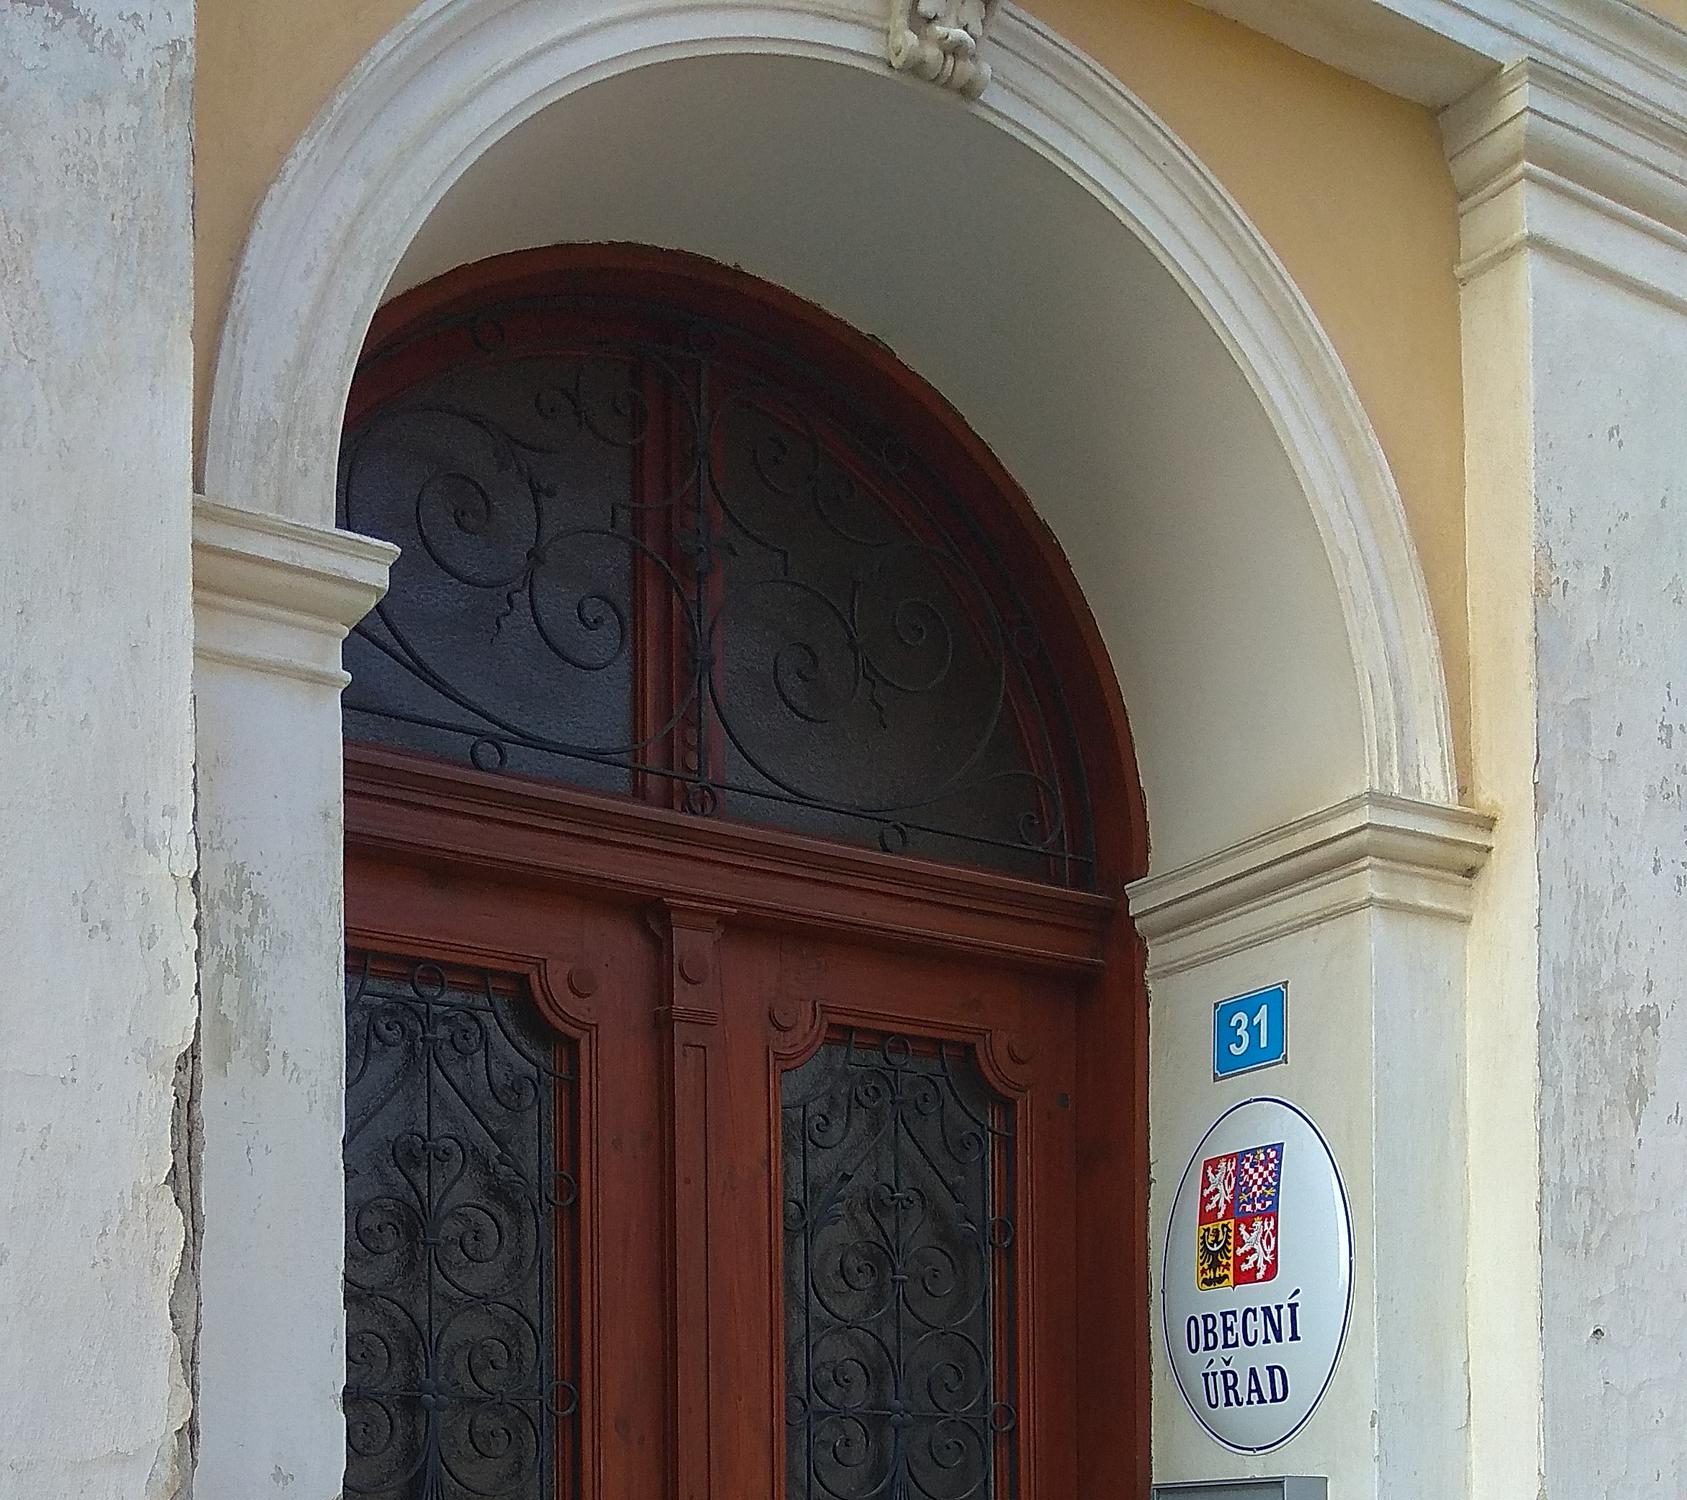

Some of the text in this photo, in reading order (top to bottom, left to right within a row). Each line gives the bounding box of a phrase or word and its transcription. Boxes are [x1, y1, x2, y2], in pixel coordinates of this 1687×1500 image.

[1228, 1003, 1270, 1057] 31
[1185, 1288, 1302, 1355] OBECNÍ
[1201, 1355, 1290, 1410] ÚŘAD
